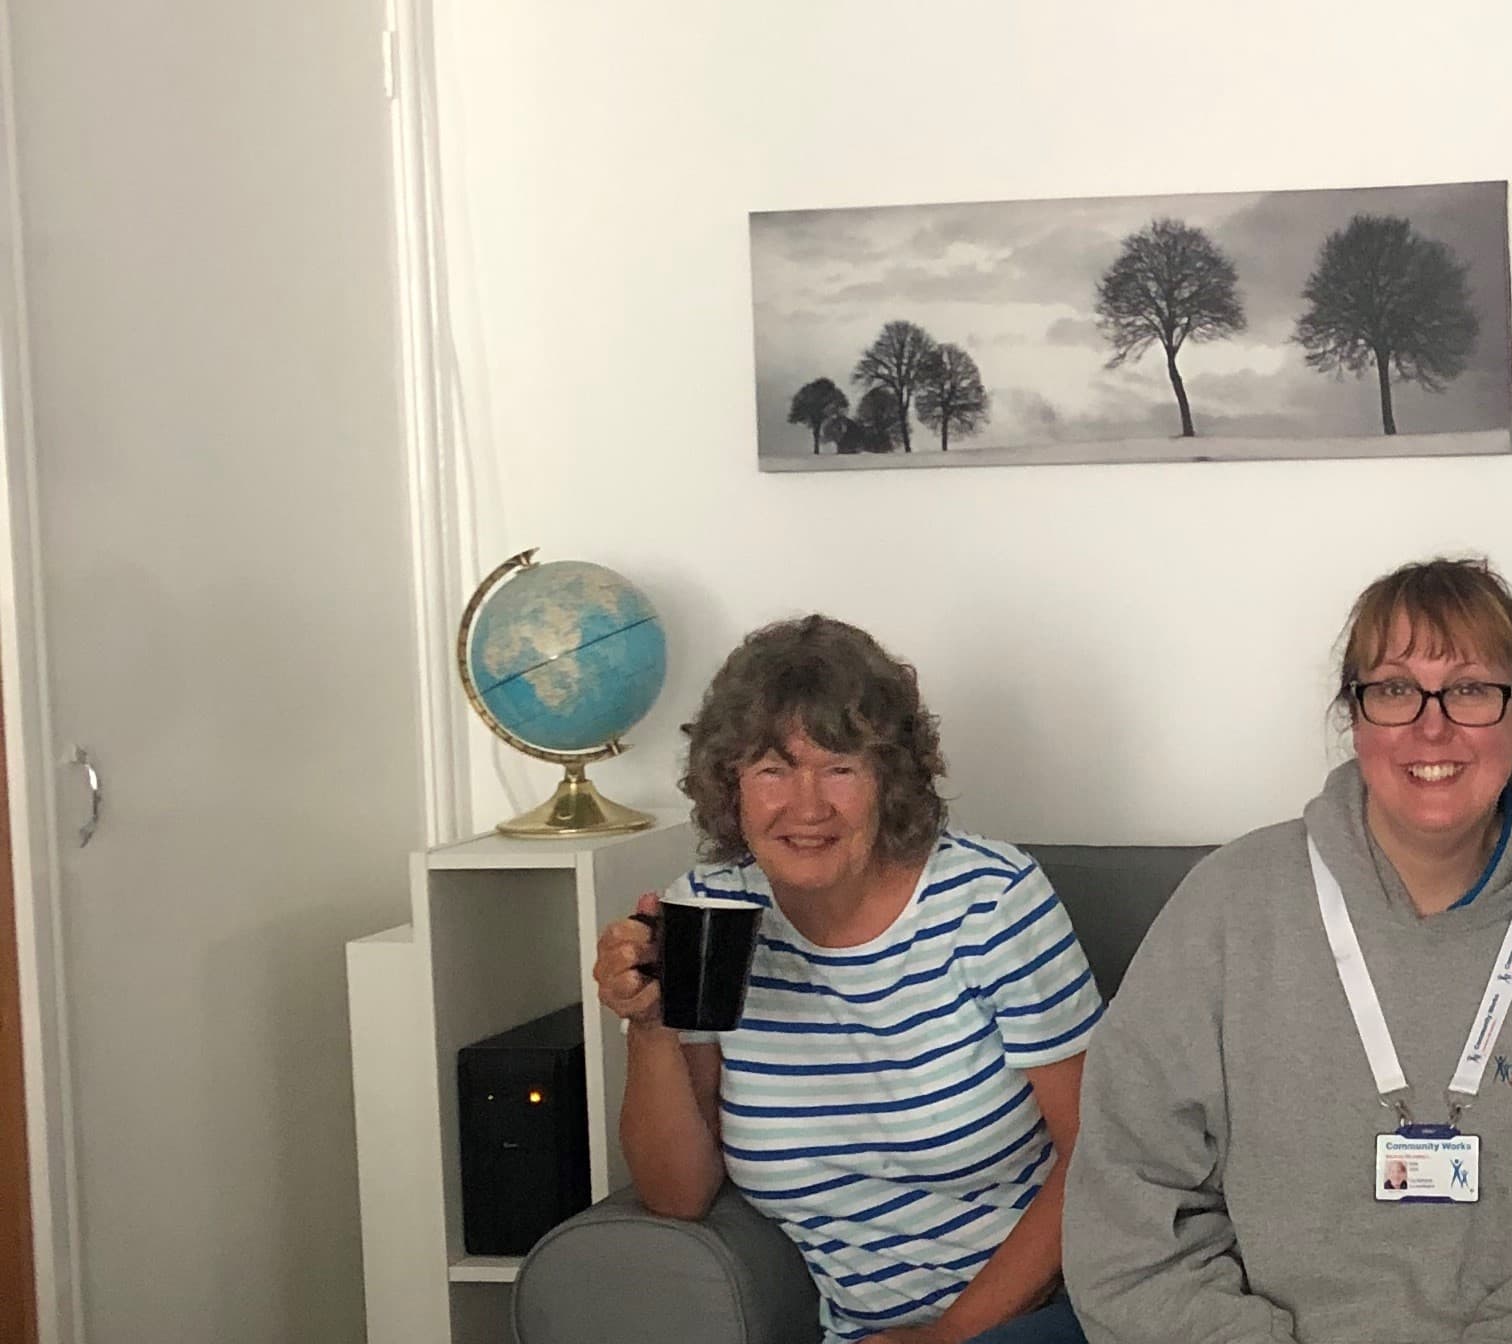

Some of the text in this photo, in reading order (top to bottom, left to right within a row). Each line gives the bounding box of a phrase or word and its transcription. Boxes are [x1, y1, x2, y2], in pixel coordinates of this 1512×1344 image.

[1474, 1015, 1493, 1050] Community
[1488, 993, 1500, 1014] Works
[1386, 1142, 1471, 1152] Community Works
